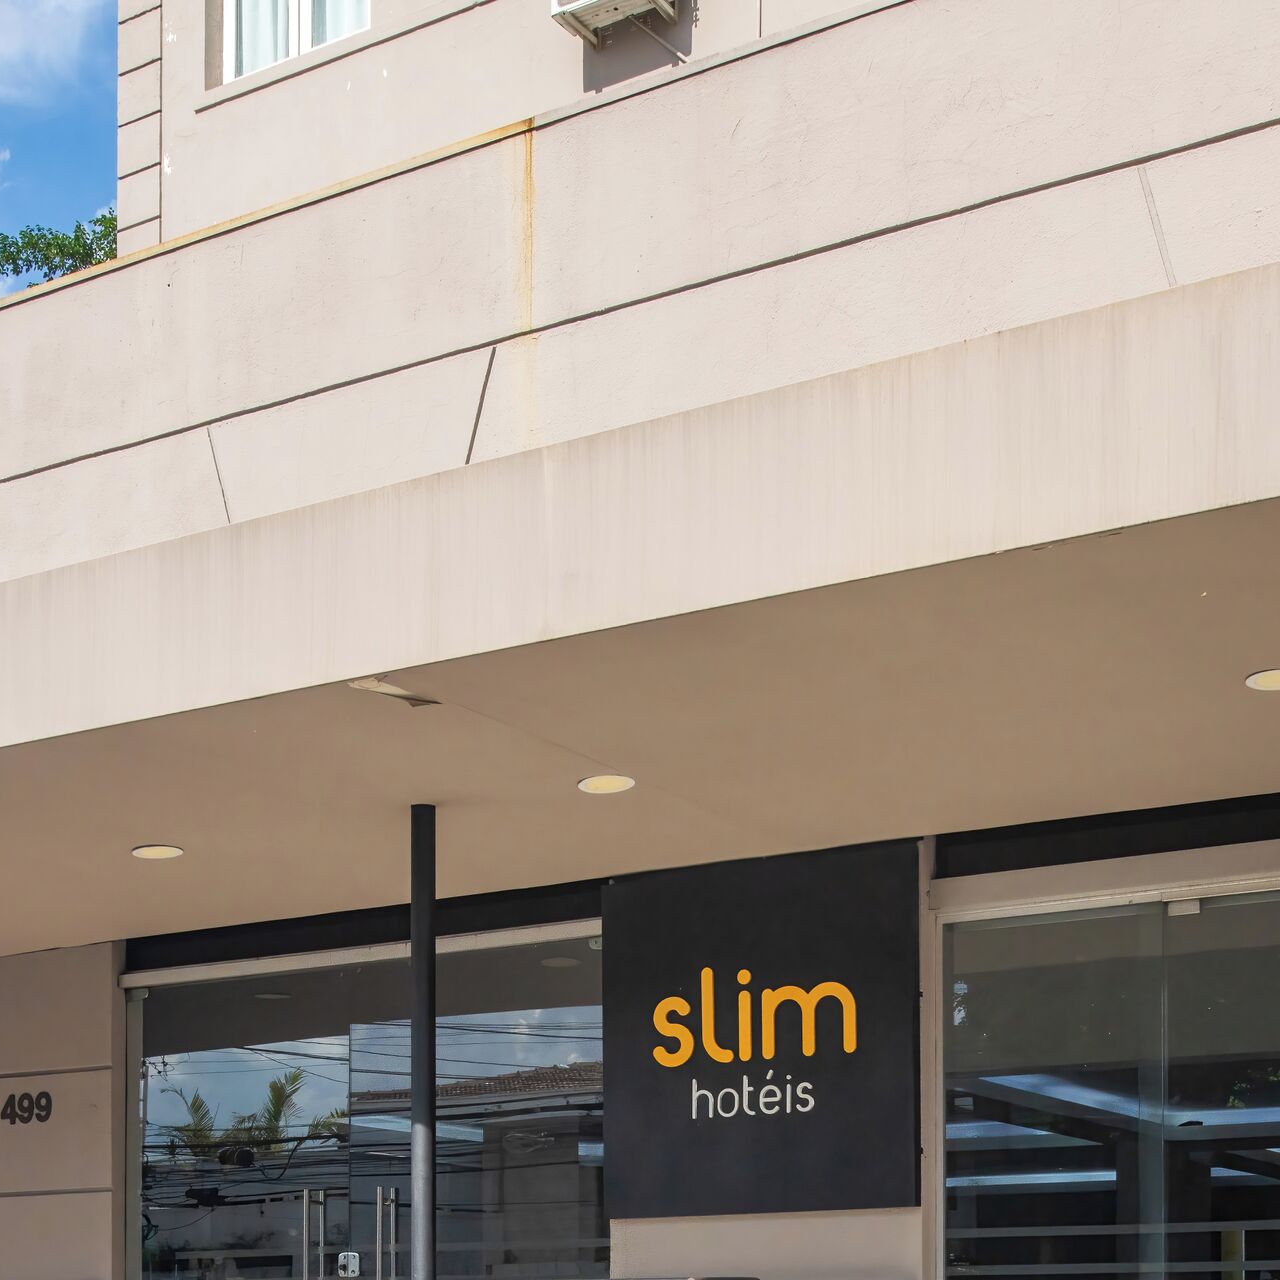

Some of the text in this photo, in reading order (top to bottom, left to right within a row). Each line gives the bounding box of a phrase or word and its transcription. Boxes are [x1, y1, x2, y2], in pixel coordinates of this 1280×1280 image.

[652, 967, 857, 1067] slim
[0, 1091, 52, 1125] 499
[691, 1069, 815, 1119] hotéis
